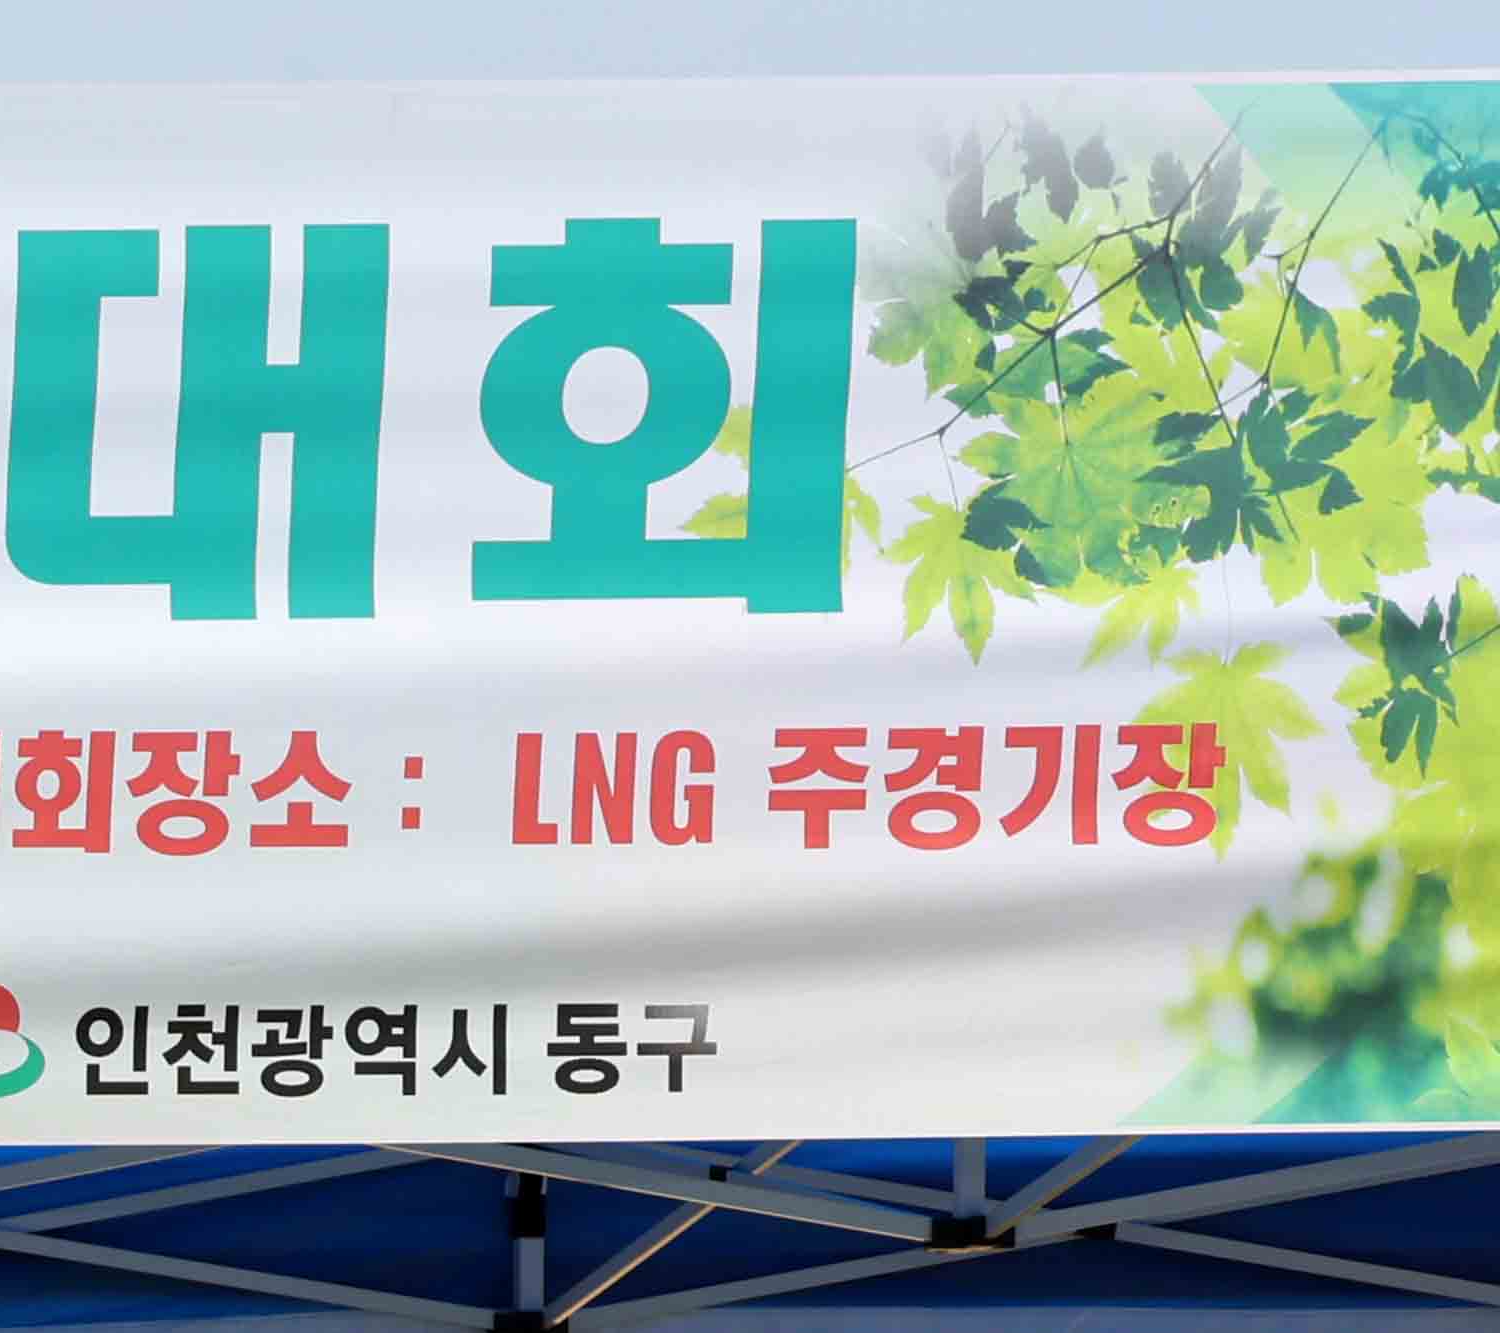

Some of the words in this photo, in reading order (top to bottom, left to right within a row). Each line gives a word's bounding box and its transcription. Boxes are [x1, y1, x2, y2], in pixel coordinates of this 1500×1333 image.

[511, 728, 718, 848] LNG
[766, 722, 1227, 852] 주경기장
[74, 1001, 509, 1099] 인천광역시
[545, 1001, 719, 1097] 동구
